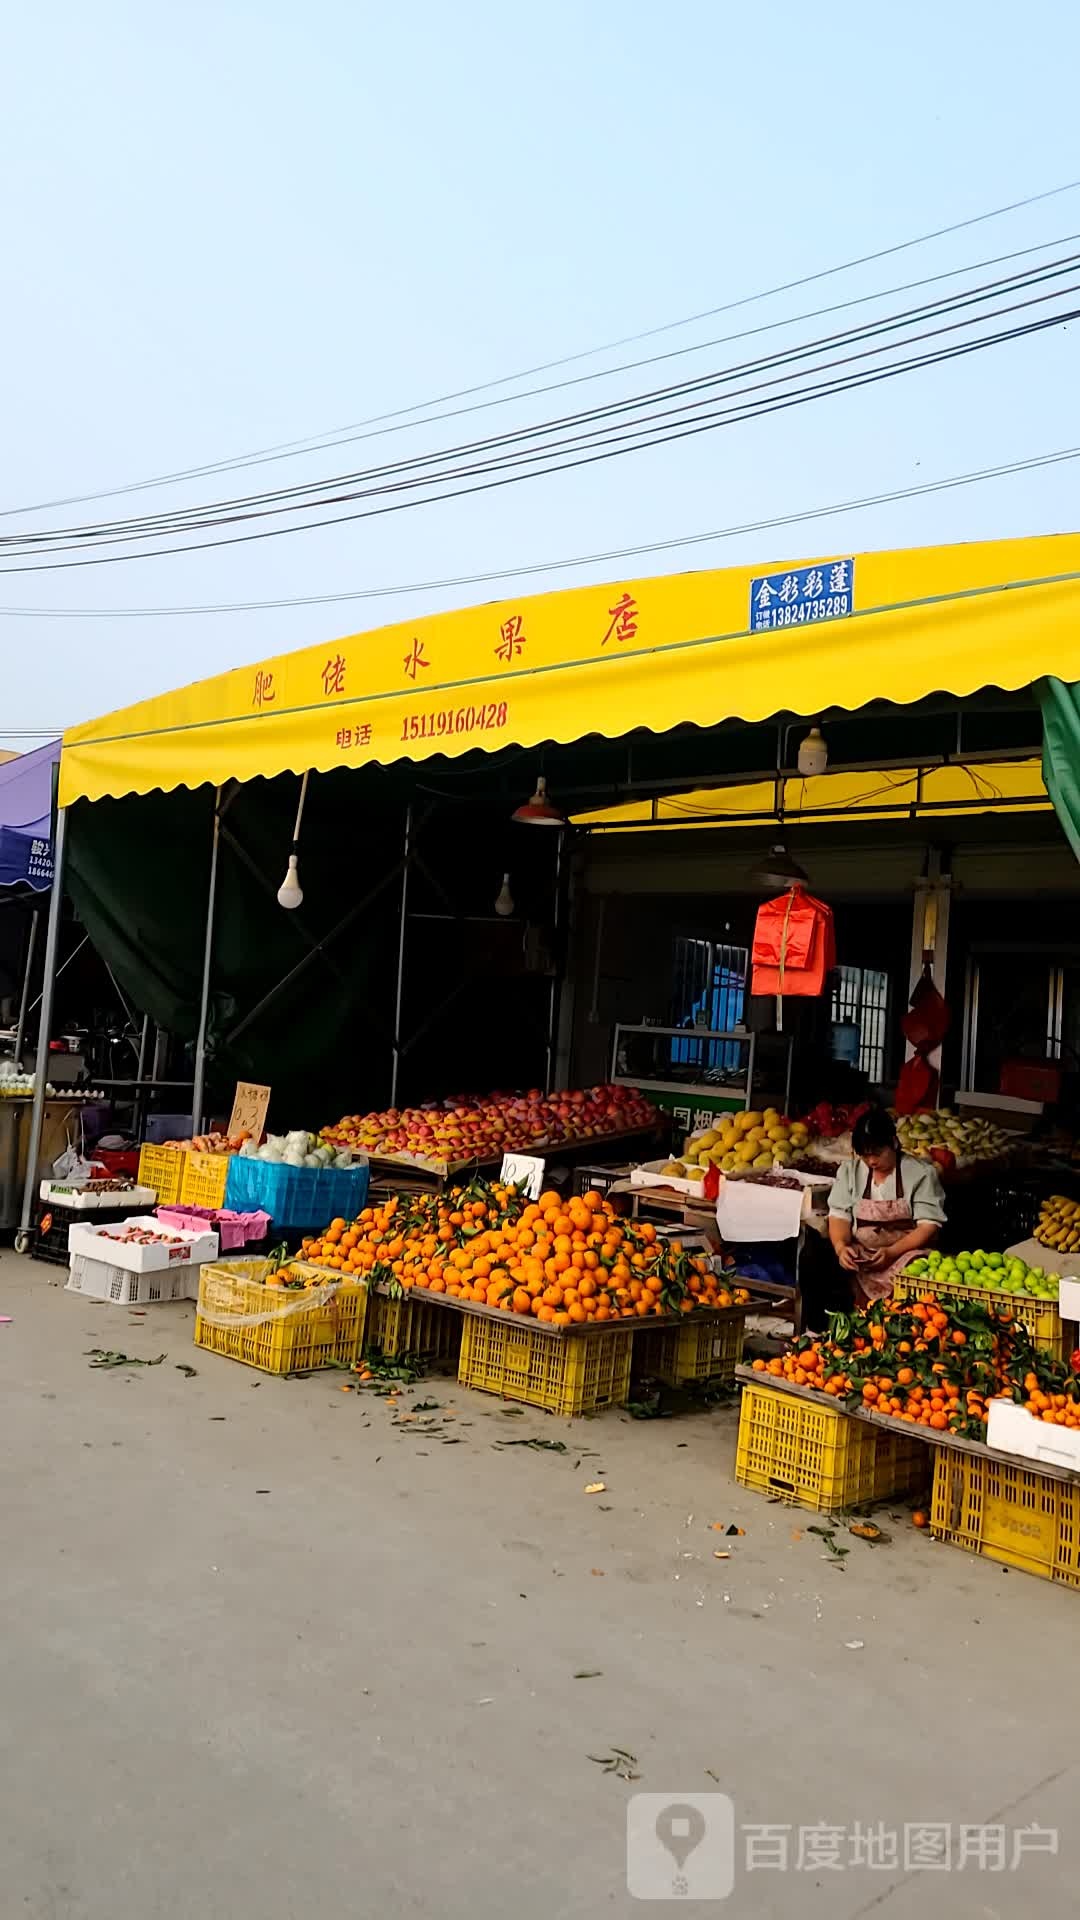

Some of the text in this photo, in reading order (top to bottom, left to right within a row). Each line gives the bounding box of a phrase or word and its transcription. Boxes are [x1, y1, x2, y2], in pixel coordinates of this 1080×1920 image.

[771, 594, 848, 627] 13824735289
[336, 701, 507, 750] 电话 15119160428
